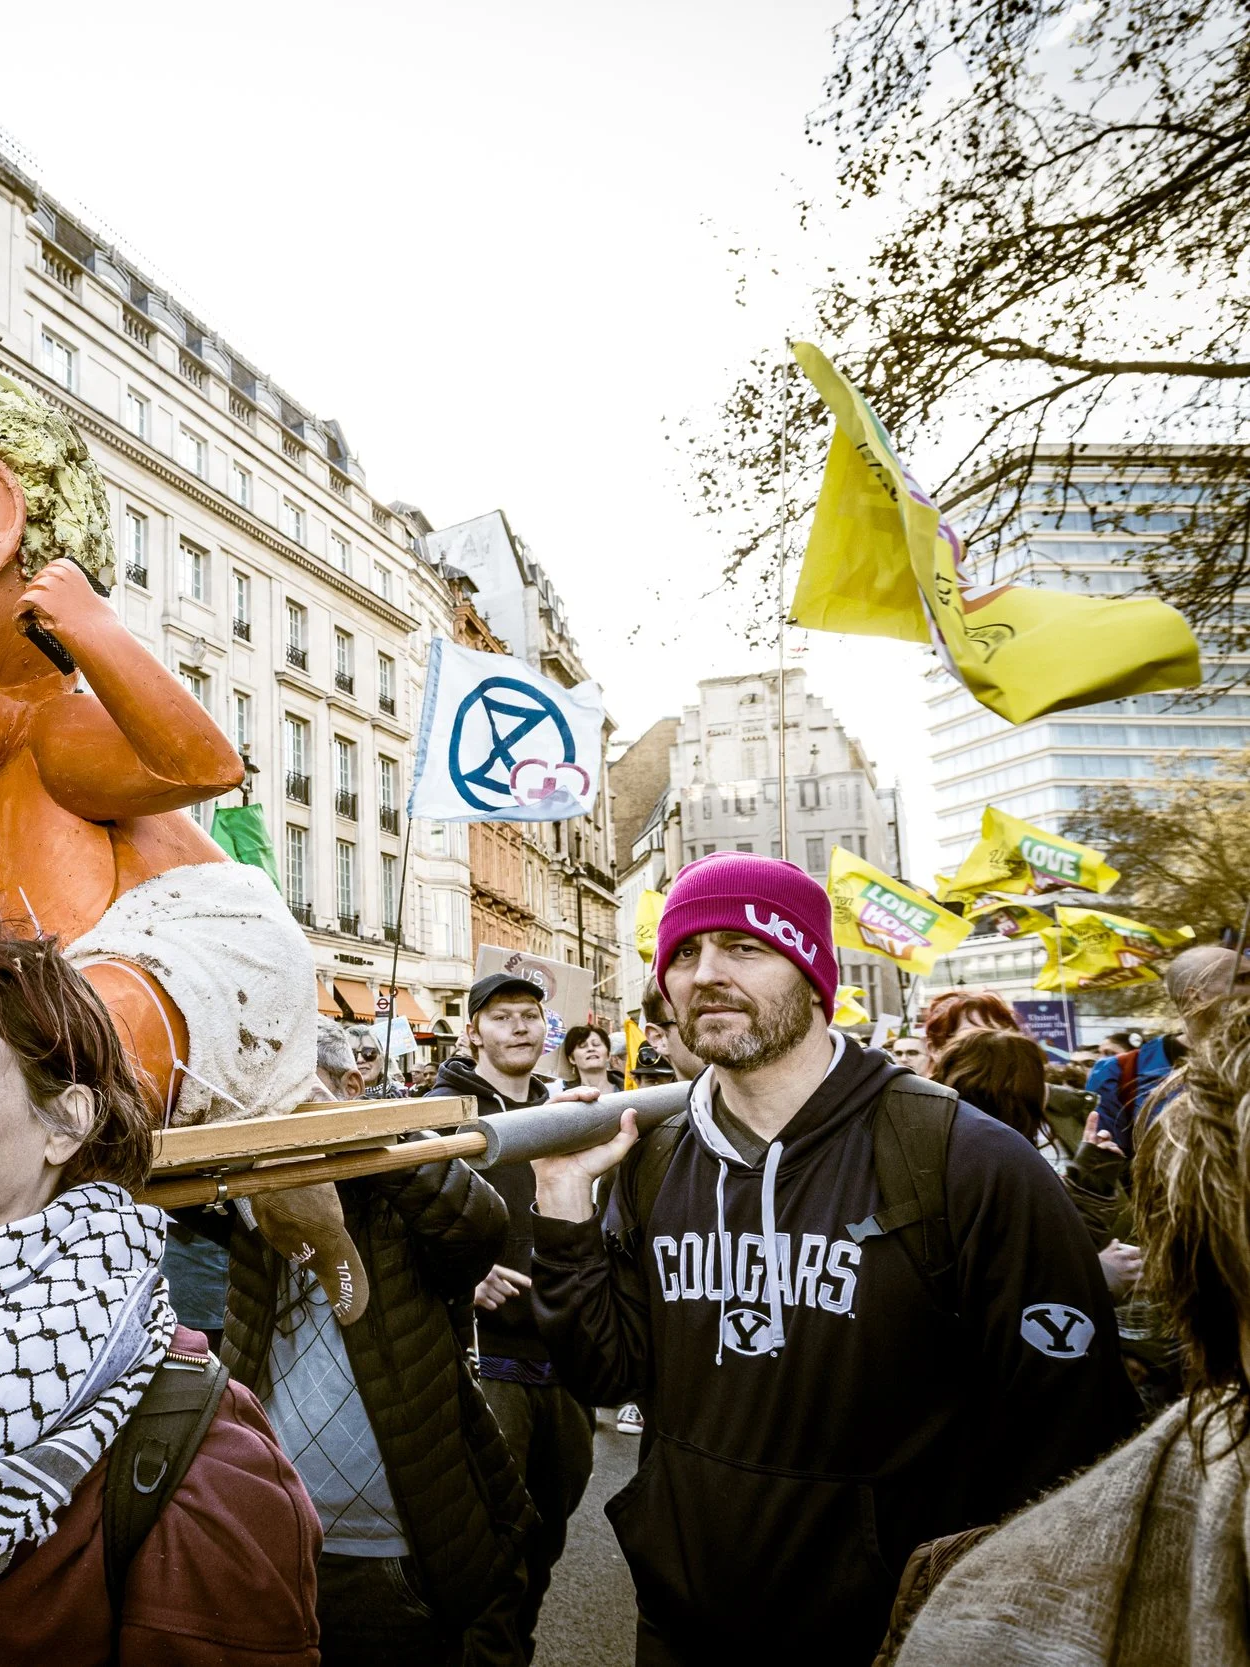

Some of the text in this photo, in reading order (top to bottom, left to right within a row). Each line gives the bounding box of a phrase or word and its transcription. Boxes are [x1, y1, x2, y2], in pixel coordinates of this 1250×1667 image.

[1022, 839, 1078, 877] LOVE
[866, 885, 933, 931] LOVE
[653, 1232, 862, 1314] COUGARS
